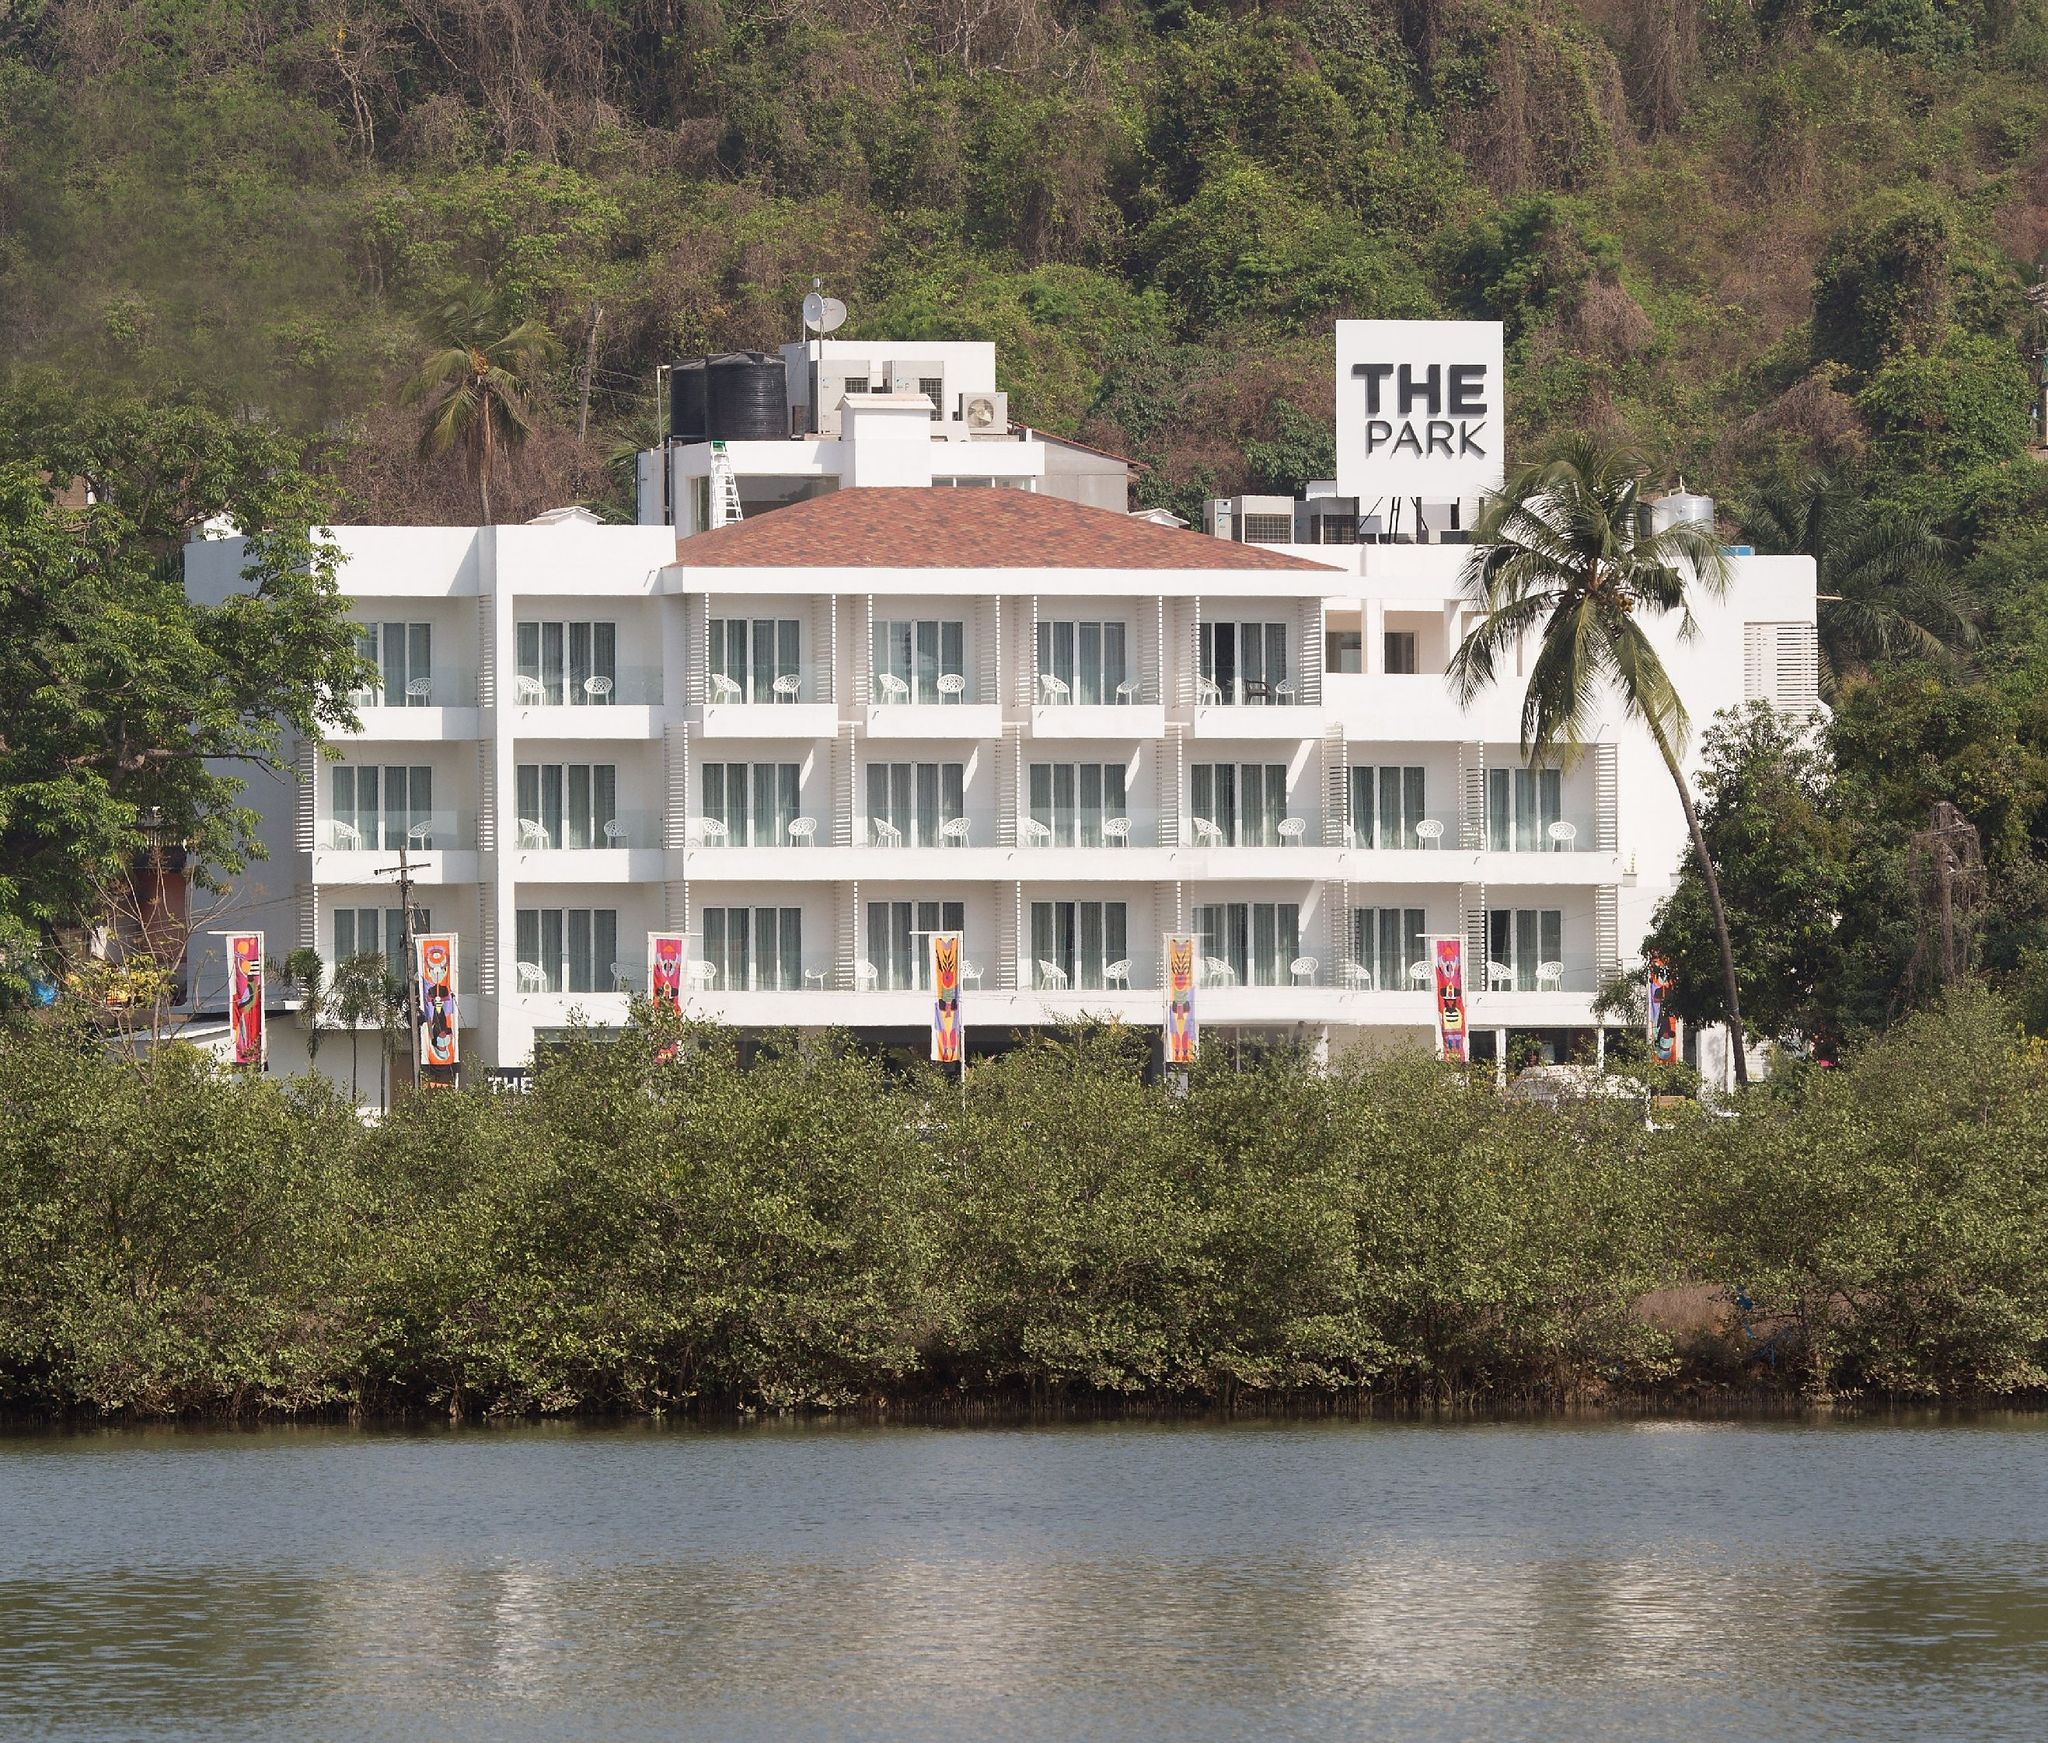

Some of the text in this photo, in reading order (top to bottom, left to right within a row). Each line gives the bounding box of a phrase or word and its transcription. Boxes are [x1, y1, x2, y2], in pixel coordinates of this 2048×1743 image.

[1352, 363, 1487, 415] THE
[1366, 420, 1487, 456] PARK
[487, 1076, 534, 1095] THE
